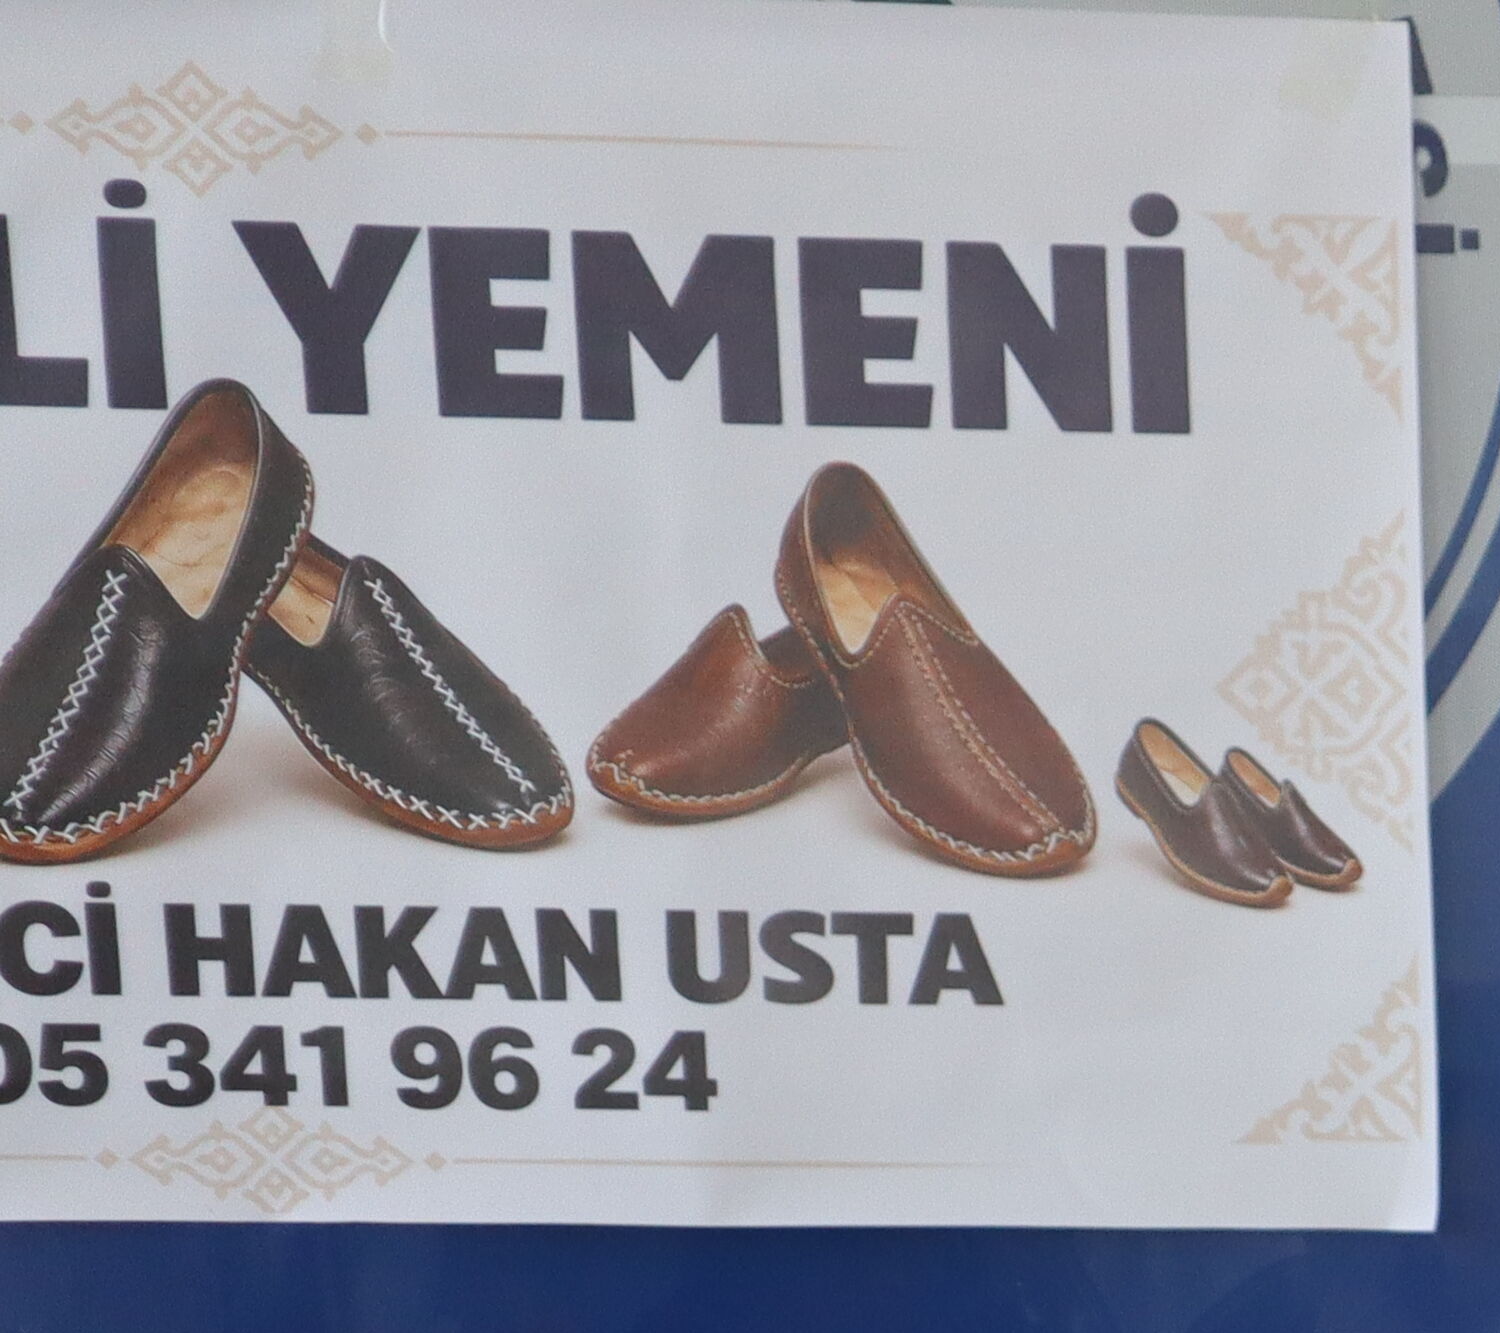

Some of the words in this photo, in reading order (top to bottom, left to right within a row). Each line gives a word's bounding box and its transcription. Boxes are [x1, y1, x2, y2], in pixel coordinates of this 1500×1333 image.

[231, 193, 1191, 435] YEMENİ
[0, 881, 122, 997] Cİ
[164, 903, 623, 1002] HAKAN
[665, 909, 1005, 1006] USTA
[144, 1023, 350, 1108] 341
[390, 1026, 540, 1110] 96
[571, 1027, 718, 1112] 24
